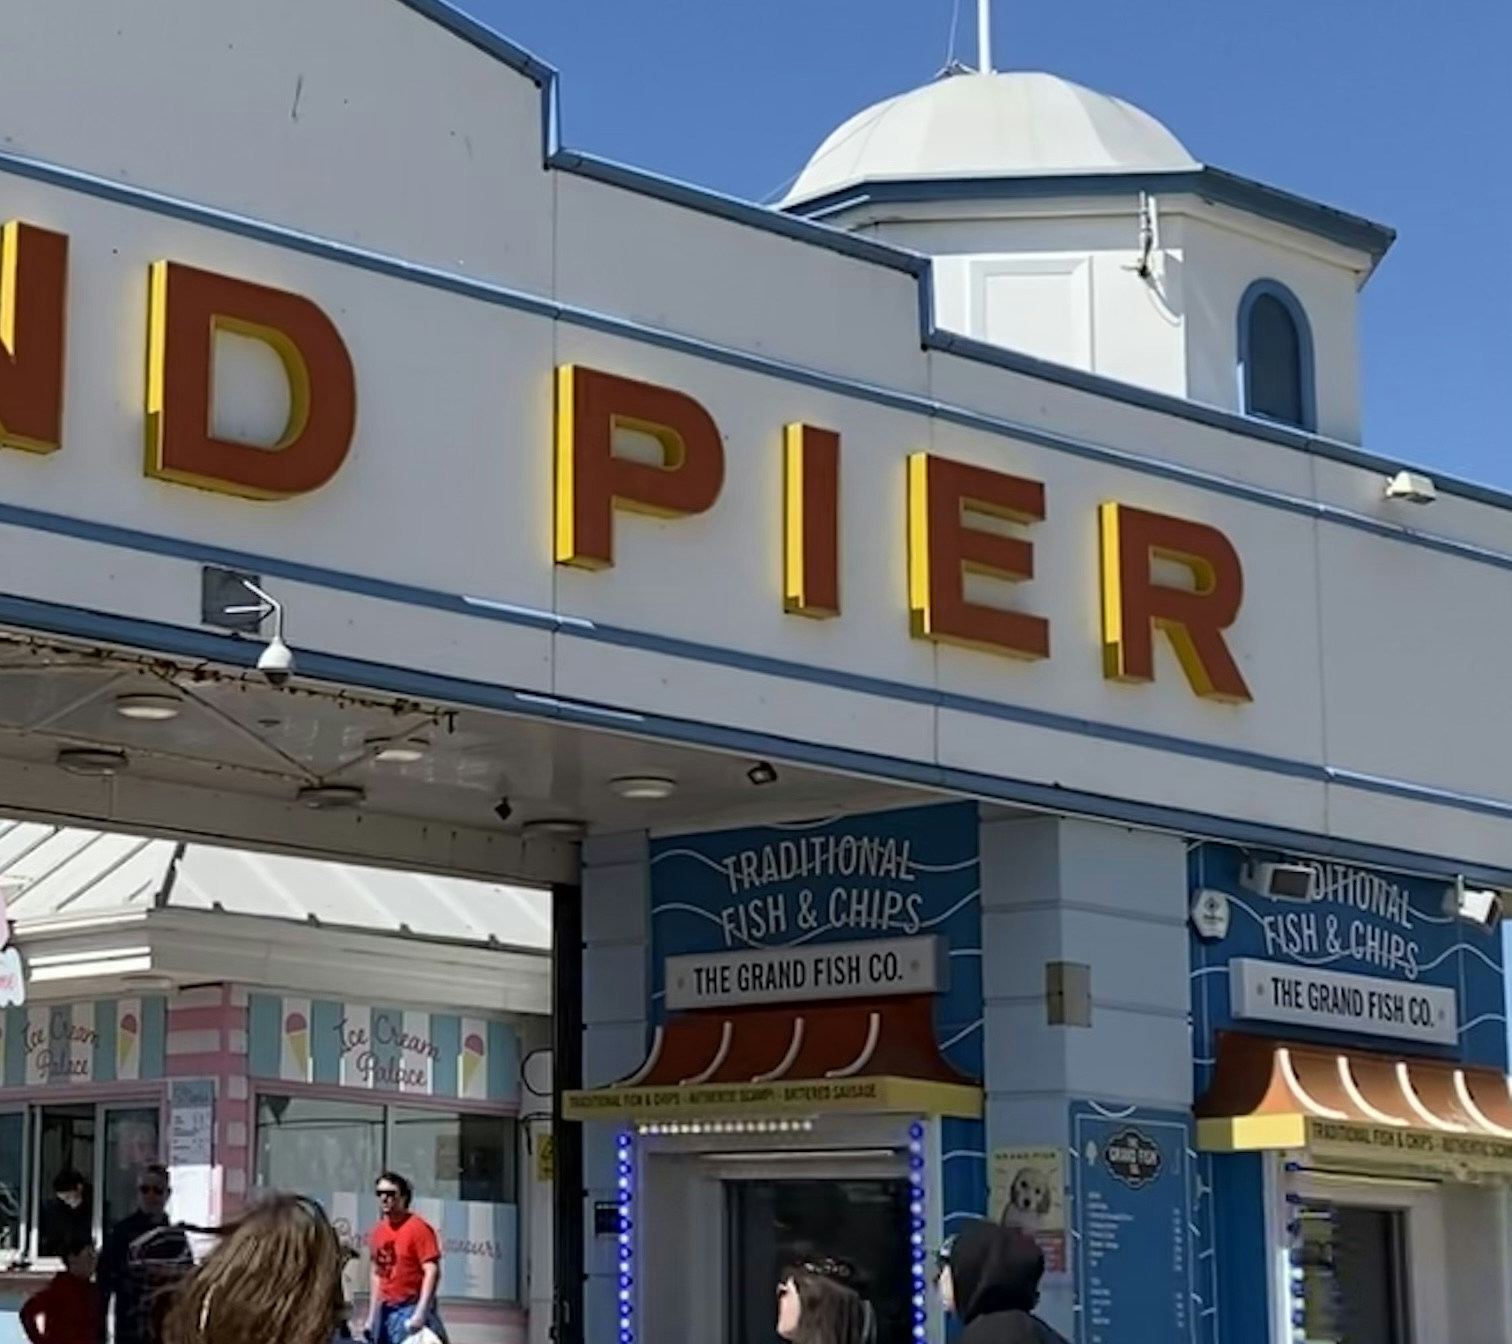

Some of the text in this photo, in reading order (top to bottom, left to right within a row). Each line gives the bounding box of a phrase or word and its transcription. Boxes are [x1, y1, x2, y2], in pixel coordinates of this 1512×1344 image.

[554, 363, 1253, 704] PIER
[723, 834, 916, 894] TRADITIONAL
[721, 886, 923, 947] FISH & CHIPS
[1298, 861, 1413, 930] DITIONAL
[1264, 905, 1419, 981] FISH & CHIPS
[694, 951, 903, 995] THE GRAND FISH CO.
[1272, 977, 1434, 1028] THE GRAND FISH CO.
[22, 1011, 99, 1054] Ice Cream
[333, 1014, 439, 1062] Ice Cream
[35, 1049, 88, 1078] Palace
[356, 1051, 427, 1087] Palace
[569, 1094, 621, 1108] TRADITIONAL
[654, 1091, 681, 1105] CHIPS
[783, 1085, 830, 1101] BATTERED
[834, 1083, 877, 1098] SAUSAGE
[1312, 1122, 1370, 1144] TRADITIONAL
[1373, 1129, 1394, 1147] FISH
[1396, 1131, 1404, 1149] &
[1405, 1133, 1434, 1151] CHIPS
